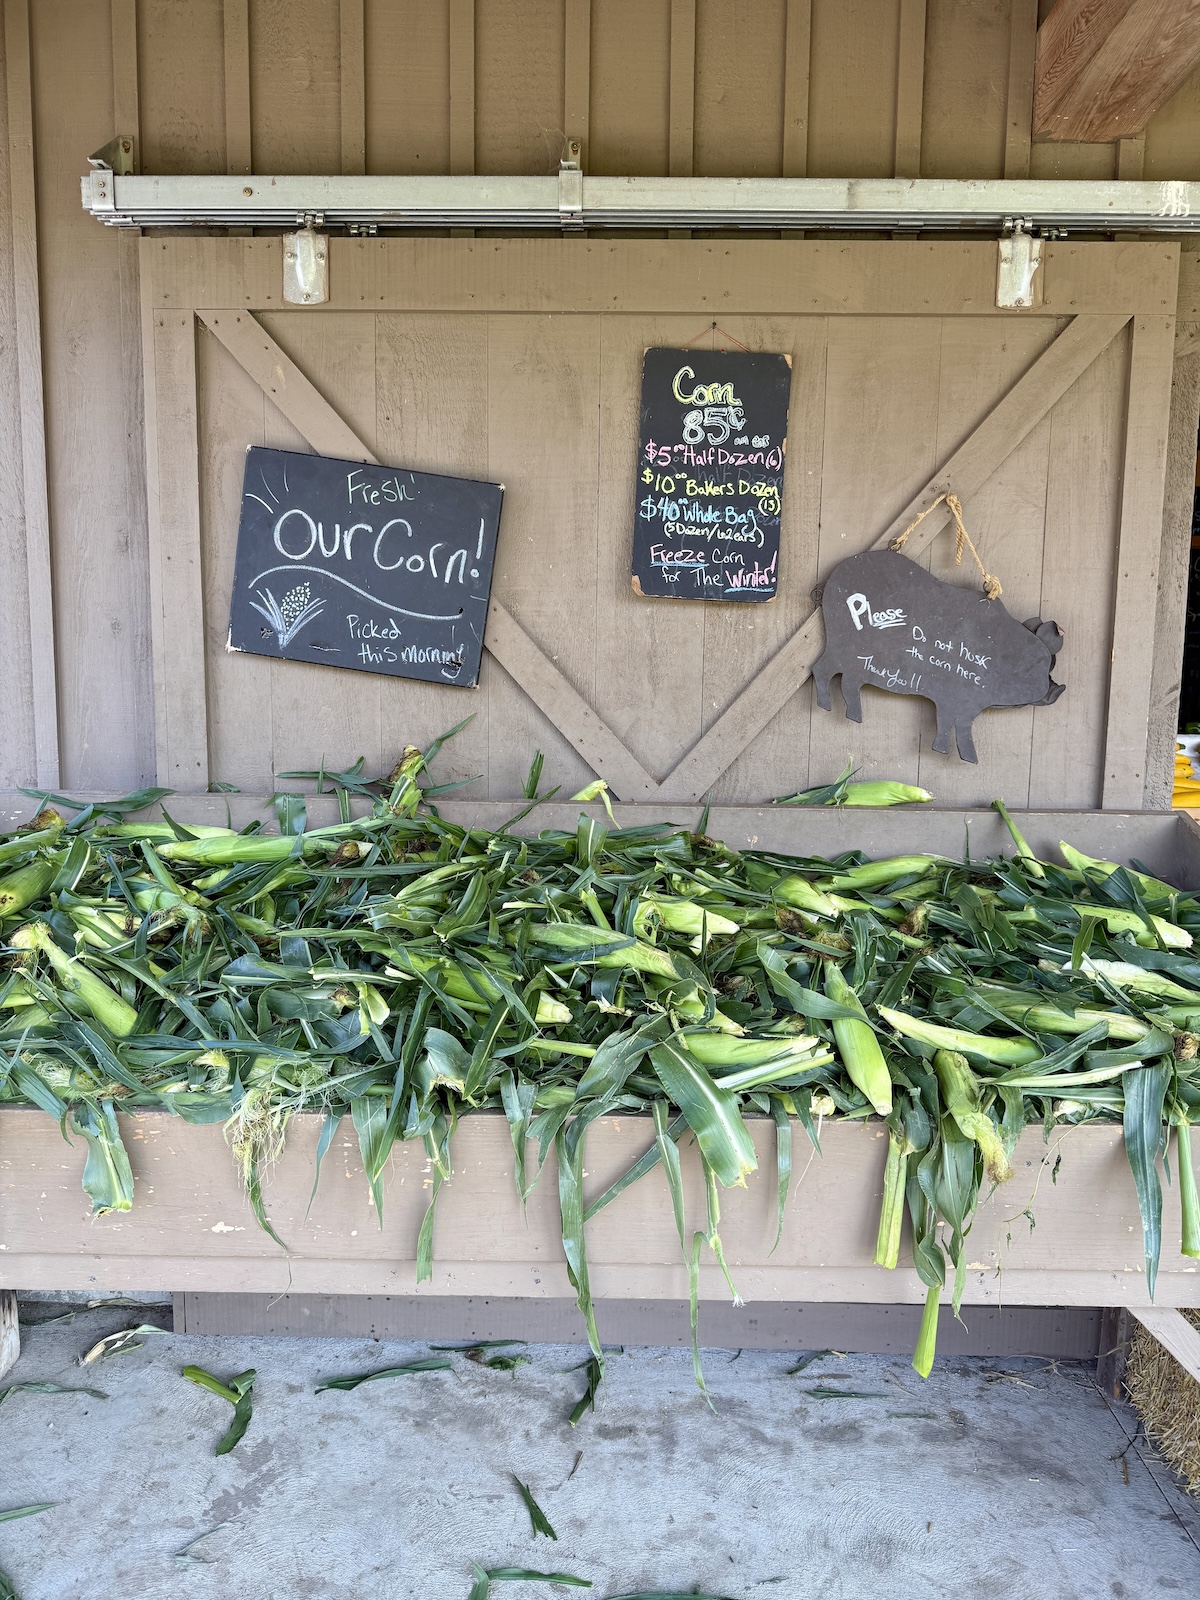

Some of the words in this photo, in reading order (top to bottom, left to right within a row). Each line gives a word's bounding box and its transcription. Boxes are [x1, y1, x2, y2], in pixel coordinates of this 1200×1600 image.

[671, 365, 742, 406] Corn
[738, 480, 780, 498] Dozen
[273, 508, 373, 561] Our
[373, 517, 484, 584] Corn!
[649, 543, 706, 564] Freeze
[711, 548, 746, 566] Corn
[661, 566, 682, 584] for
[690, 567, 724, 587] The
[846, 592, 908, 631] Please
[346, 613, 402, 640] Picked
[912, 625, 927, 643] Do
[934, 639, 954, 653] not
[357, 643, 398, 664] this
[905, 646, 924, 662] the
[929, 655, 952, 672] corn
